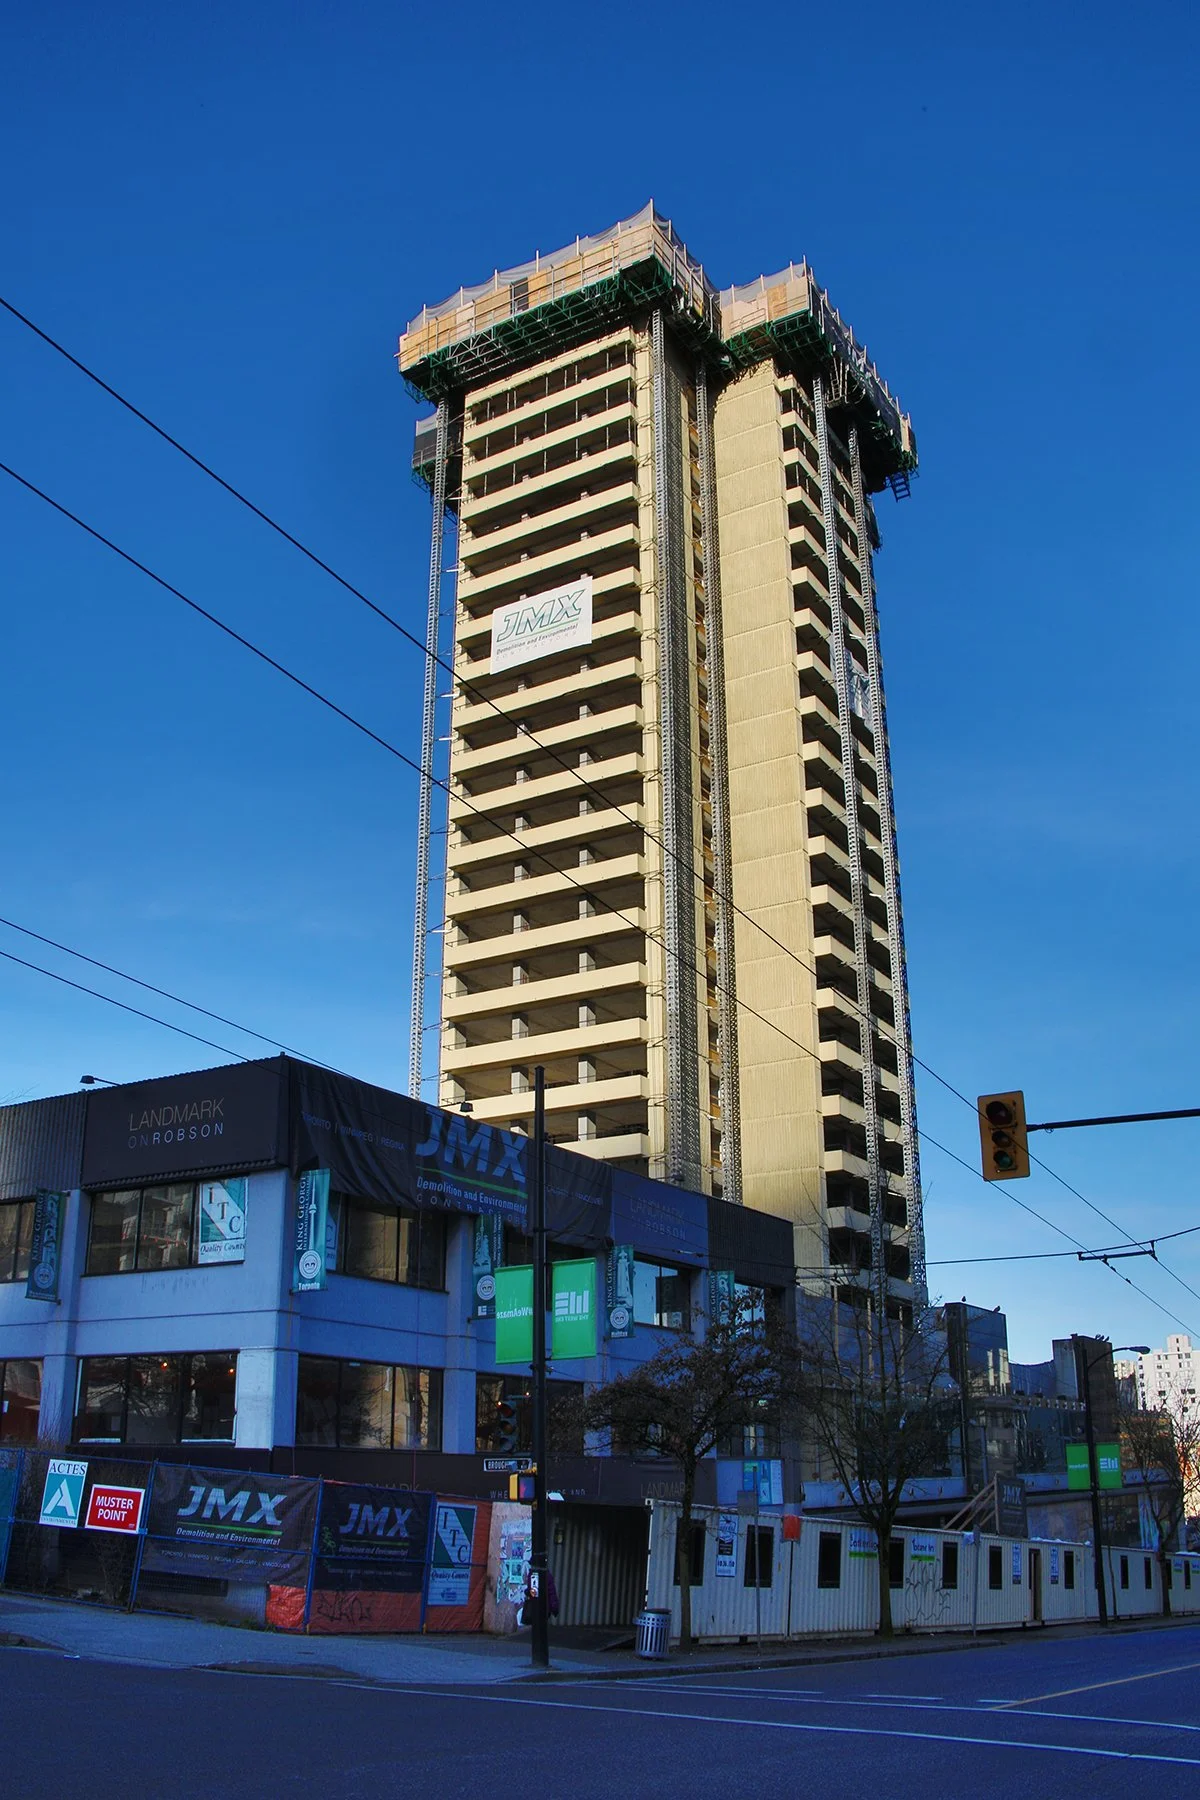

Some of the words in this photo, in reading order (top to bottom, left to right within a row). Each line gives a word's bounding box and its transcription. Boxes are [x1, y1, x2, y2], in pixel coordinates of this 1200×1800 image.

[496, 588, 586, 642] JMX
[496, 641, 526, 655] Demolition
[527, 637, 537, 645] and
[538, 623, 578, 642] Environmental
[129, 1097, 225, 1132] LANDMARK
[416, 1105, 528, 1183] JMX
[208, 1186, 241, 1233] ITC
[416, 1175, 462, 1197] Demolition
[463, 1190, 478, 1201] and
[479, 1192, 528, 1215] Environmental
[200, 1242, 222, 1256] Quality
[296, 1223, 304, 1250] KING
[50, 1462, 86, 1475] ACTES
[95, 1495, 134, 1510] MUSTER
[176, 1485, 288, 1526] JMX
[641, 1481, 686, 1499] LANDMAR
[1002, 1485, 1022, 1505] JMX
[97, 1508, 128, 1522] POINT
[339, 1503, 414, 1538] JMX
[176, 1527, 215, 1539] Demolition
[215, 1532, 230, 1541] and
[230, 1533, 281, 1546] Environmental
[443, 1511, 468, 1563] ITC
